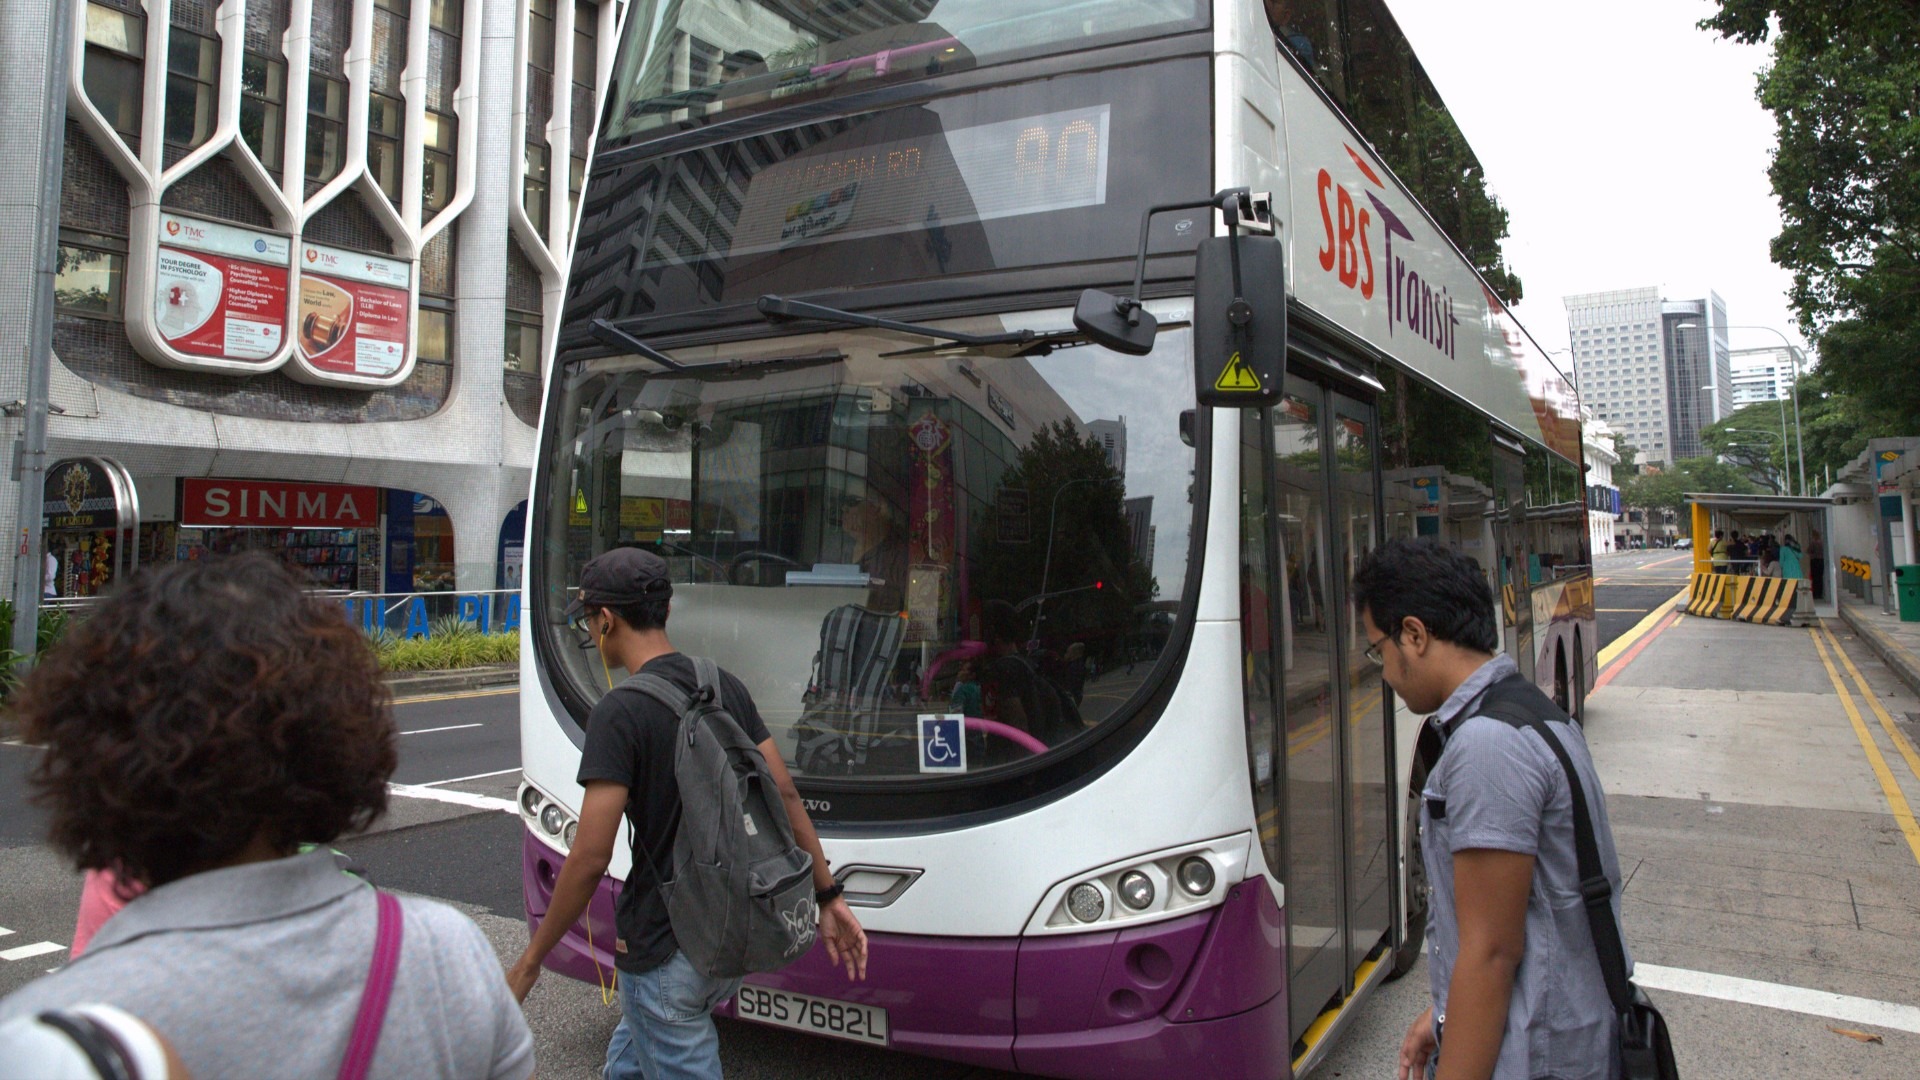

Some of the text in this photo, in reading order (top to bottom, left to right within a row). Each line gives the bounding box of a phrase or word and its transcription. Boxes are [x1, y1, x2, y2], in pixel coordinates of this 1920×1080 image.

[184, 226, 205, 238] TMC
[321, 253, 338, 264] TMC
[178, 261, 200, 269] DEGREE
[1317, 168, 1461, 361] SBS Transit
[168, 266, 207, 276] PSYCHOLOGY
[230, 271, 257, 281] Psychology
[230, 277, 258, 287] Counselling
[229, 294, 256, 304] Psychology
[246, 290, 267, 299] Diploma
[228, 300, 257, 310] Counselling
[304, 298, 321, 306] World
[360, 296, 382, 305] Bachelor
[359, 311, 381, 319] Diploma
[204, 487, 360, 520] SINMA
[739, 987, 884, 1040] SBS7682L
